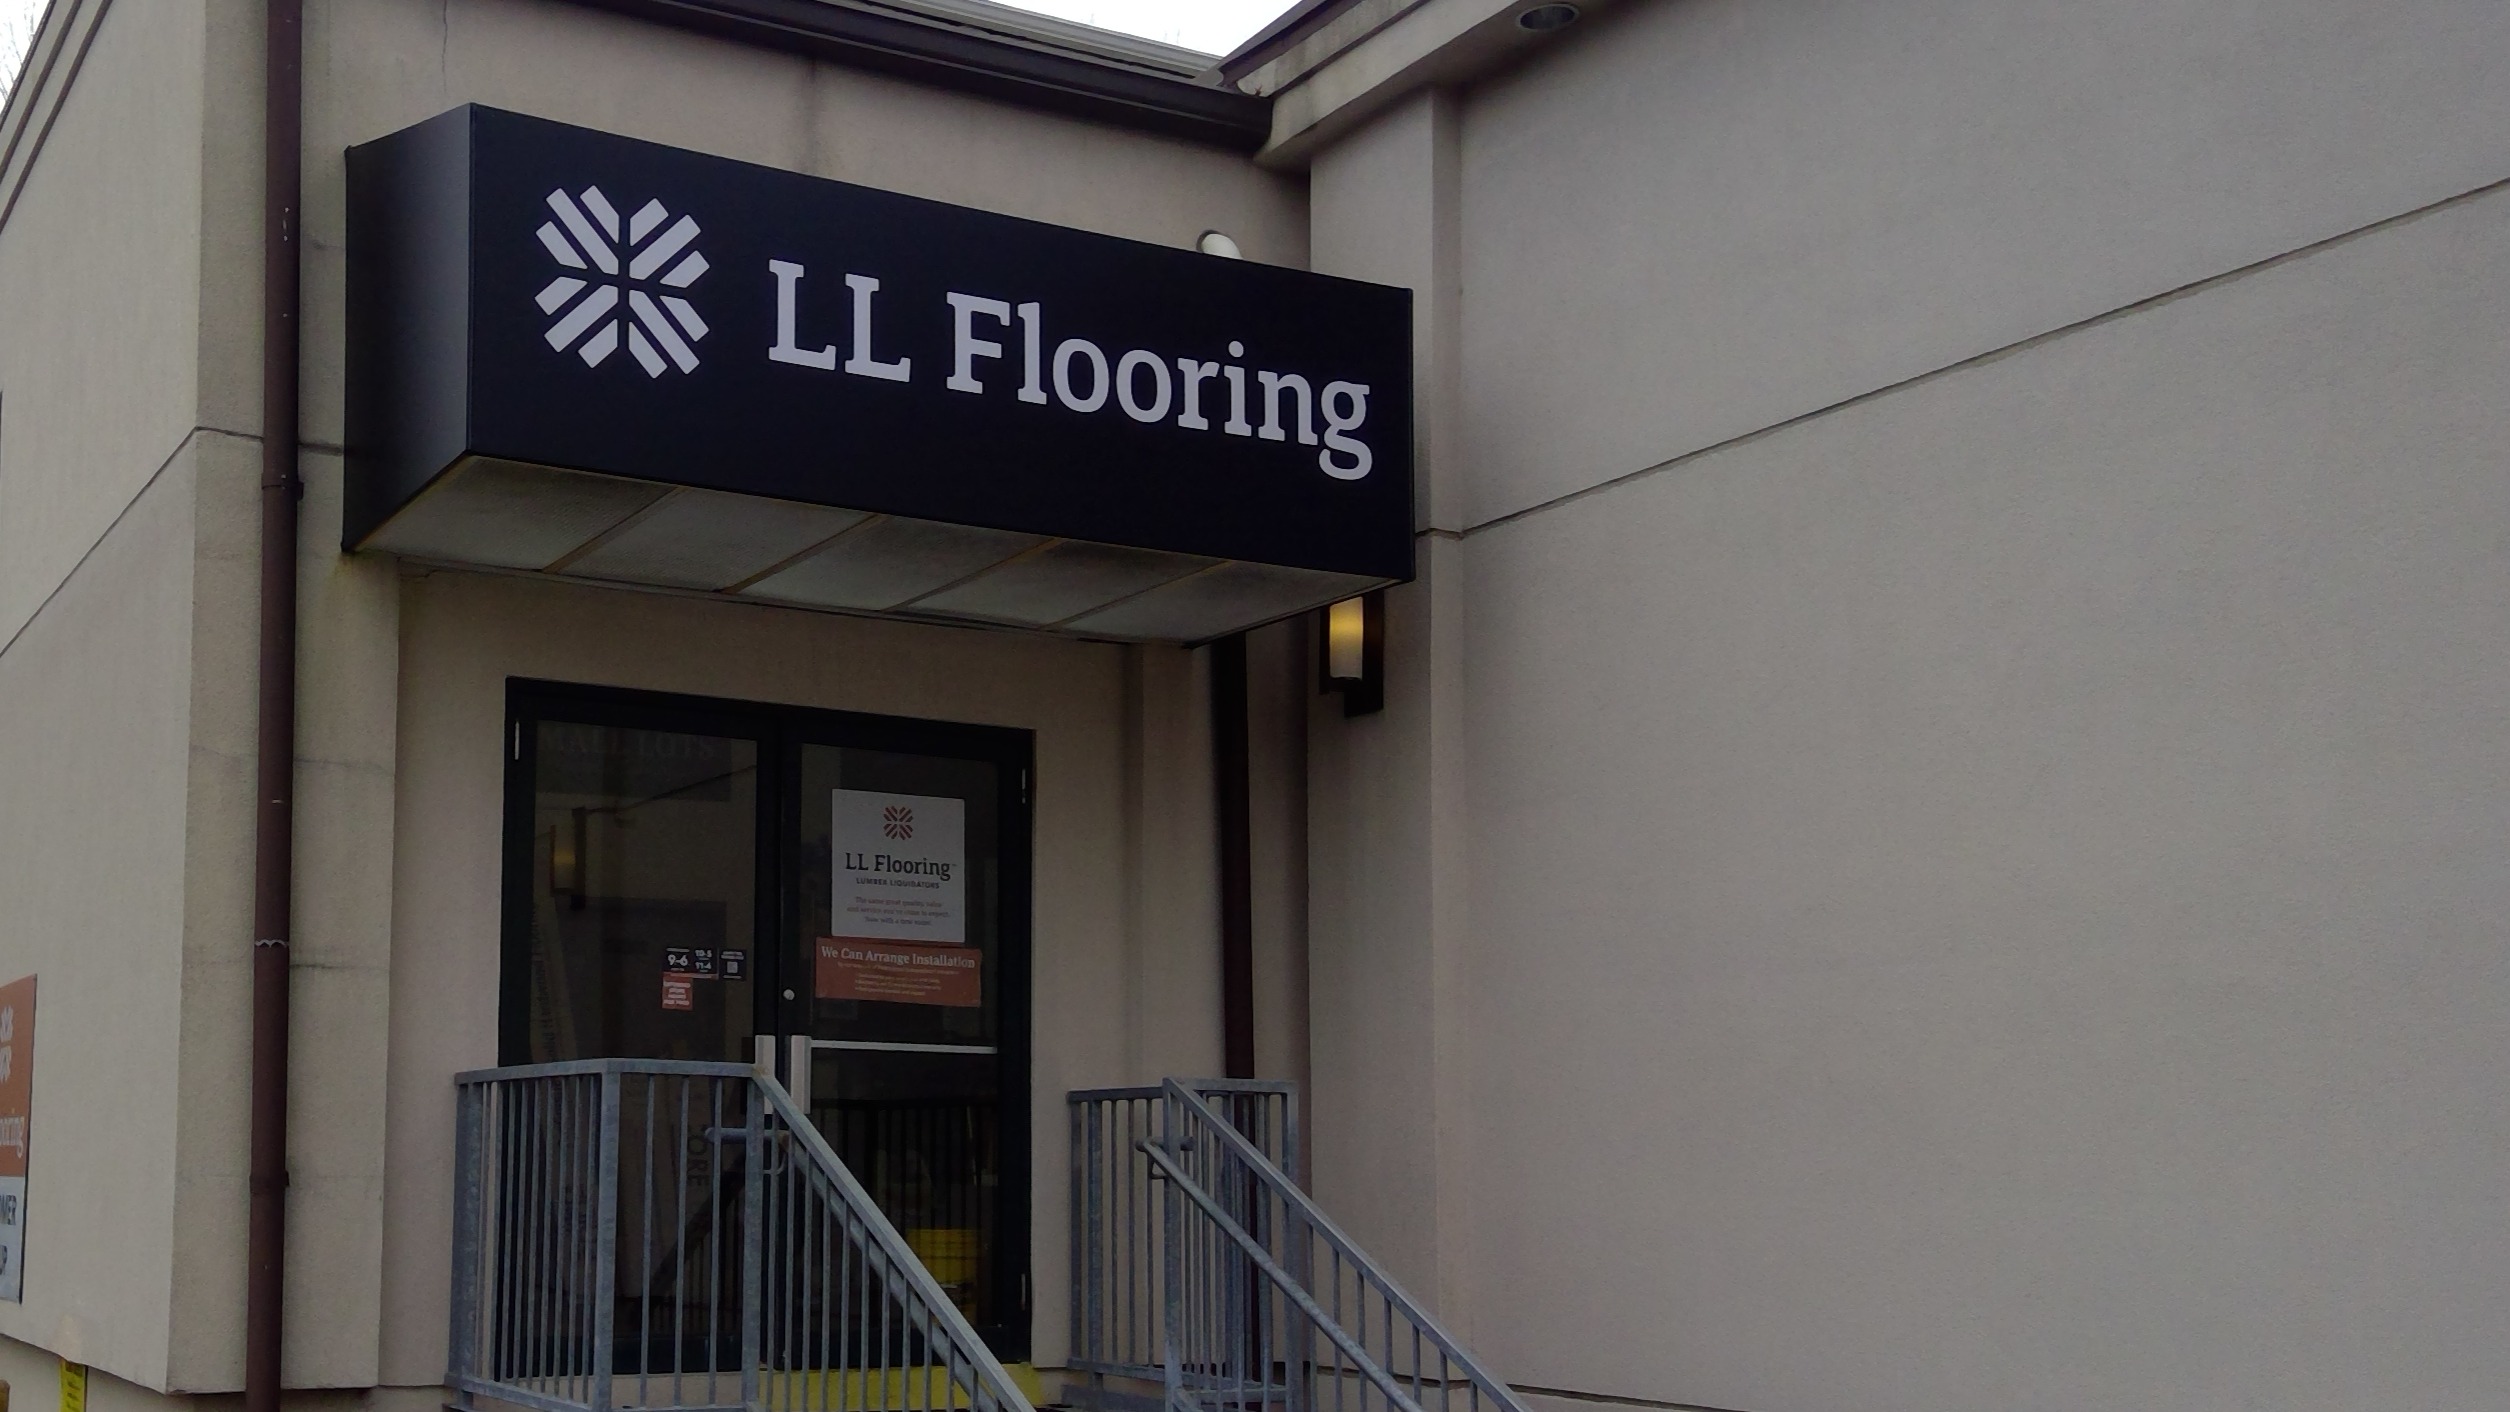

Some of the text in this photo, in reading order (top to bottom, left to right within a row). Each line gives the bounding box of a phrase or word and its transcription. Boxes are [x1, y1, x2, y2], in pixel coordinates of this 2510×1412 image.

[768, 258, 1373, 481] LL Flooring
[845, 852, 951, 881] LL Flooring
[856, 877, 940, 889] LUMBER LIQUIDATORS
[667, 954, 689, 966] 9-6
[821, 946, 975, 968] We Can Arrange Installation
